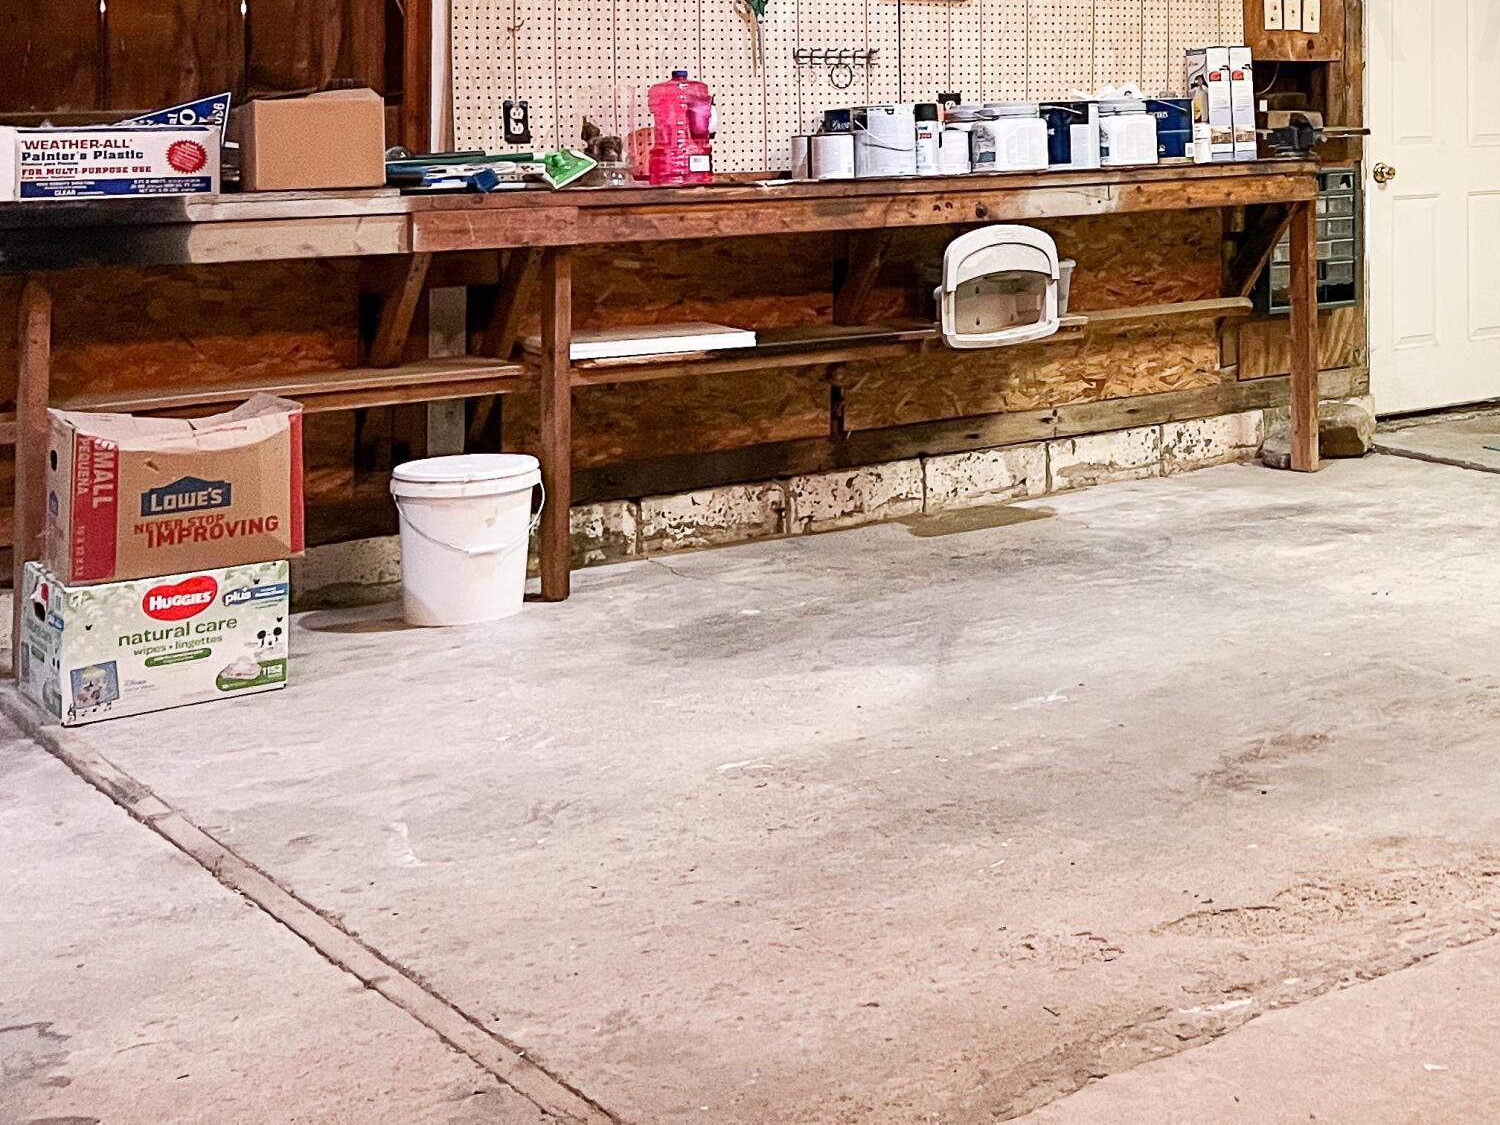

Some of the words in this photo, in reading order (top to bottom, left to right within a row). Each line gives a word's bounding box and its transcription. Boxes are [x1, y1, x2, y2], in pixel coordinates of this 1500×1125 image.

[22, 151, 87, 161] Painter's
[93, 149, 144, 160] Plastic
[22, 168, 42, 176] FOR
[92, 438, 116, 509] SMALL
[150, 487, 223, 512] LOWE'S
[133, 518, 183, 535] NEVER
[187, 514, 225, 527] STOP
[147, 515, 279, 550] IMPROVING
[118, 622, 190, 647] natural
[195, 617, 238, 634] care
[133, 645, 166, 657] wipes
[175, 634, 223, 650] lingettes
